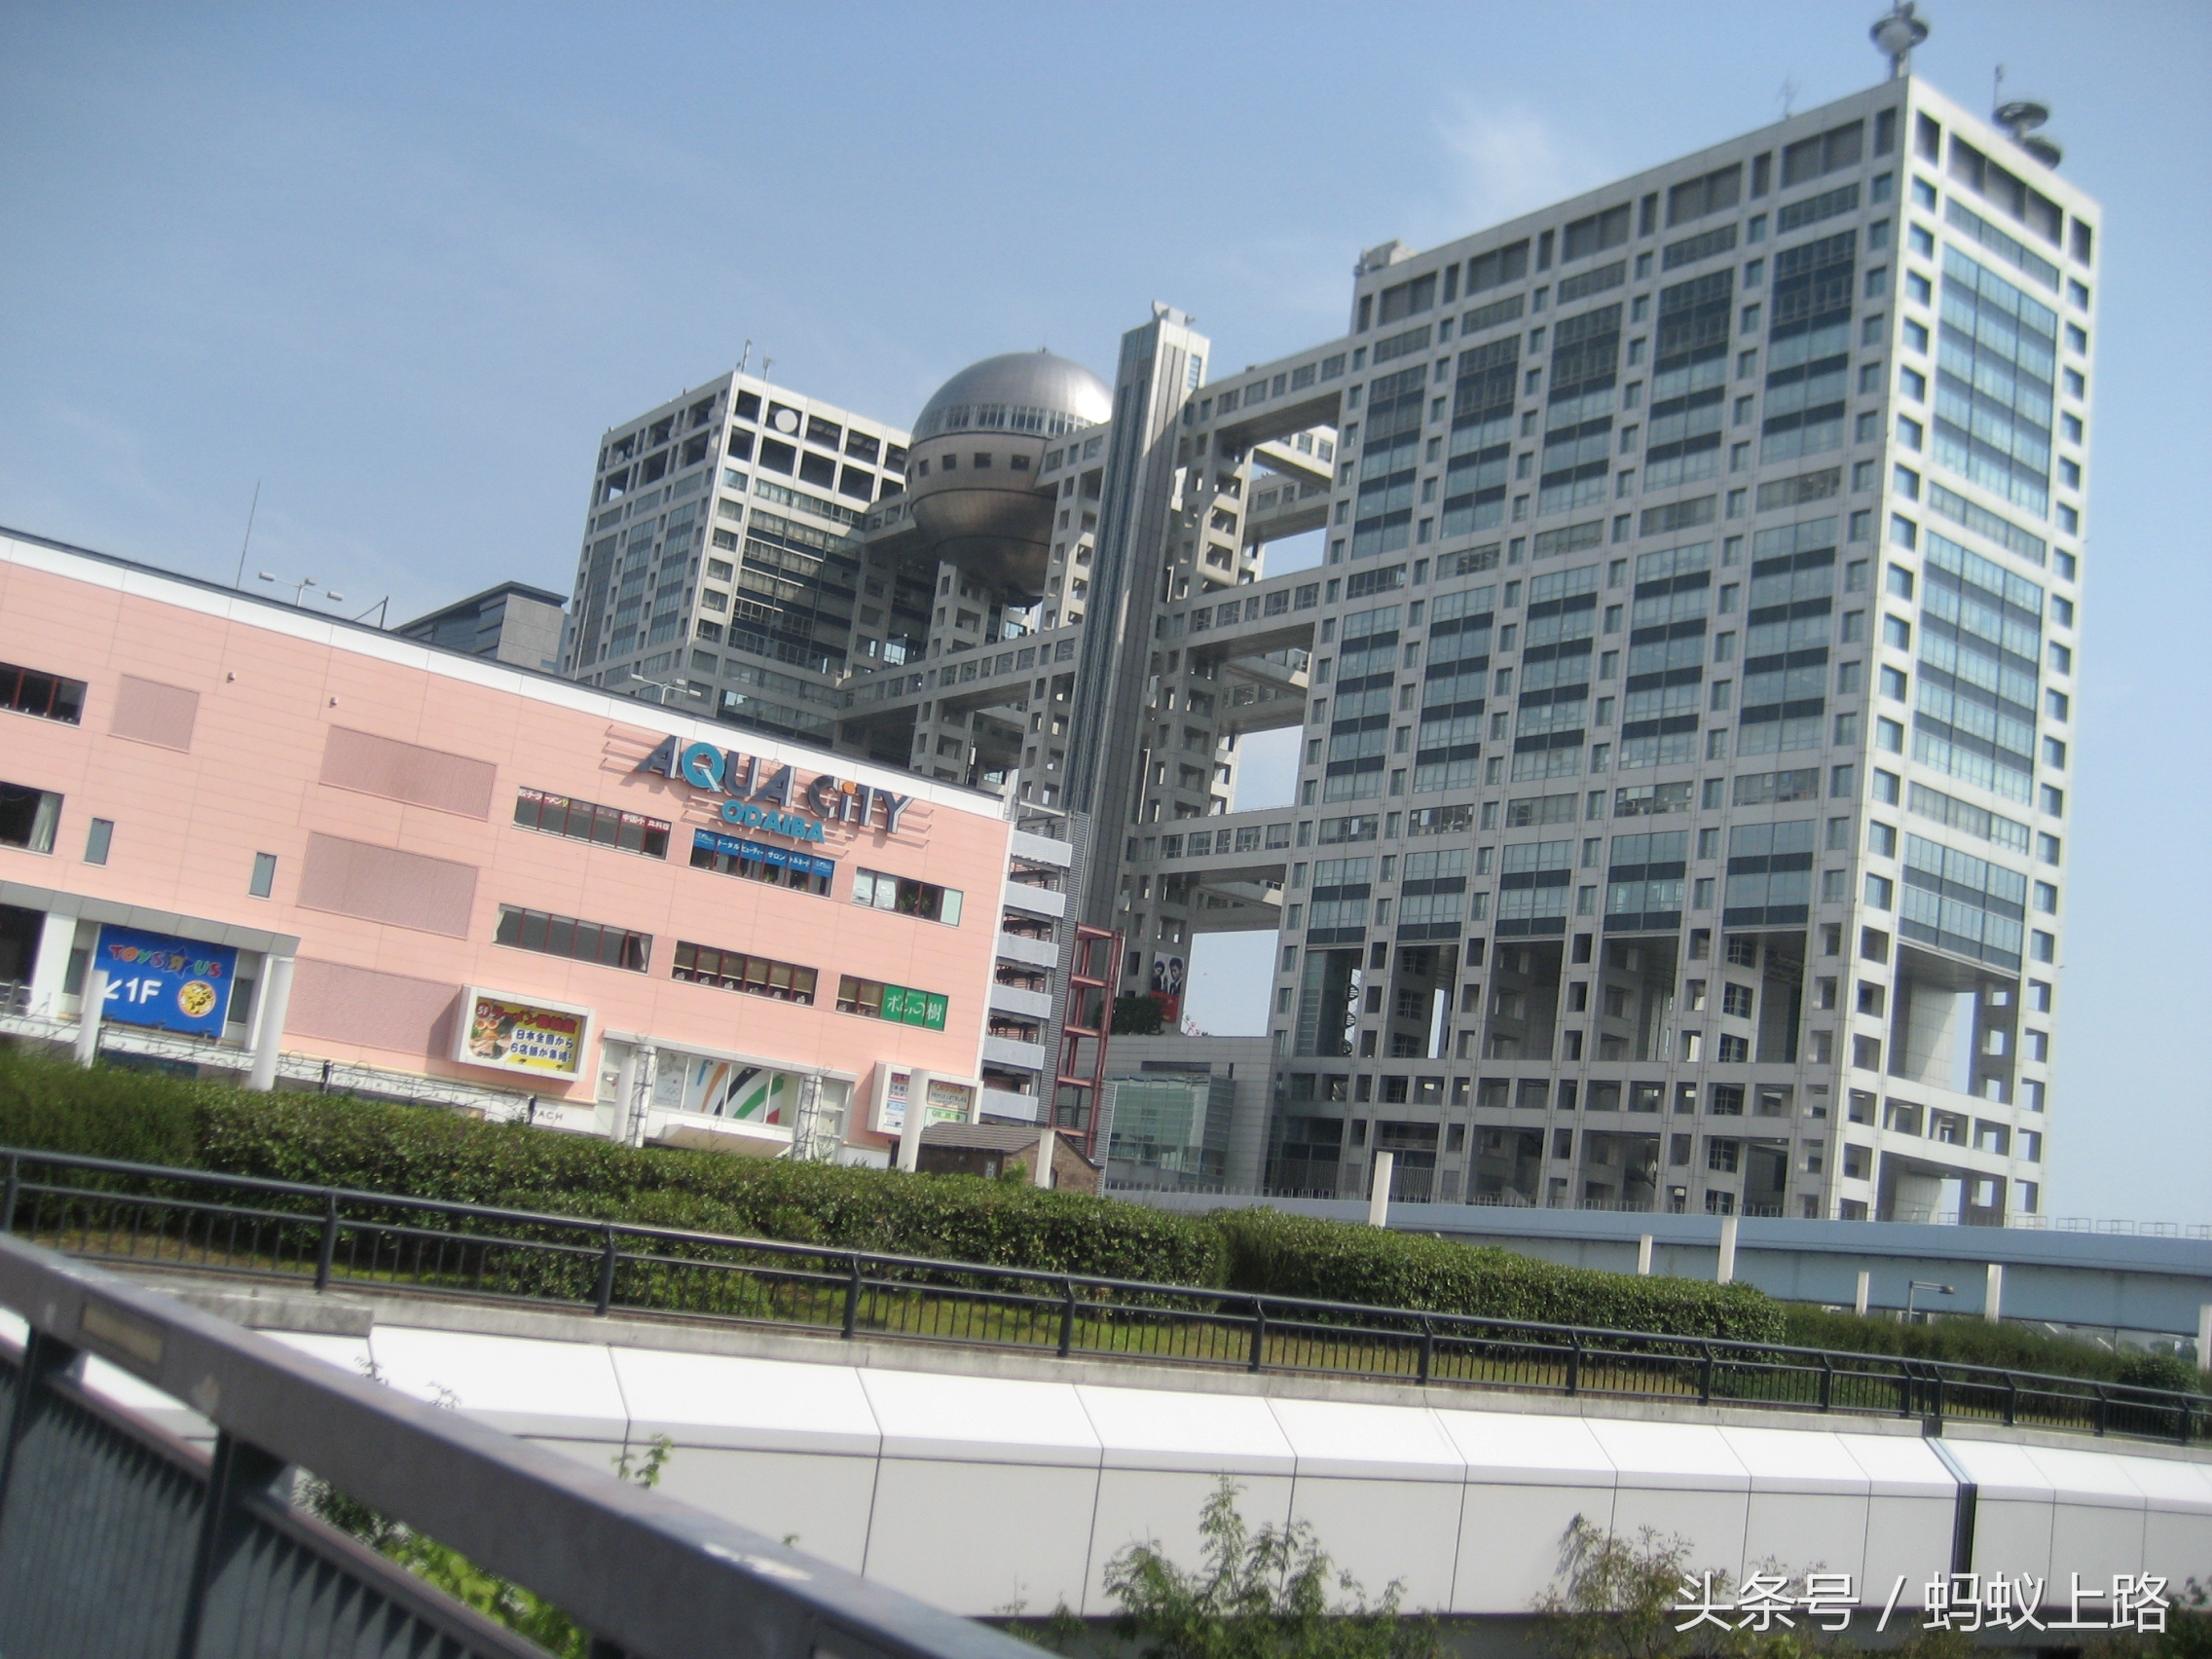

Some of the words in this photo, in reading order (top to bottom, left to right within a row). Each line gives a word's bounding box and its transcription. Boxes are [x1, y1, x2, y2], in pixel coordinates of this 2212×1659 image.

[635, 735, 796, 807] AQUA
[721, 798, 826, 844] ODAIBA
[108, 944, 164, 968] TOYS
[194, 959, 221, 978] US
